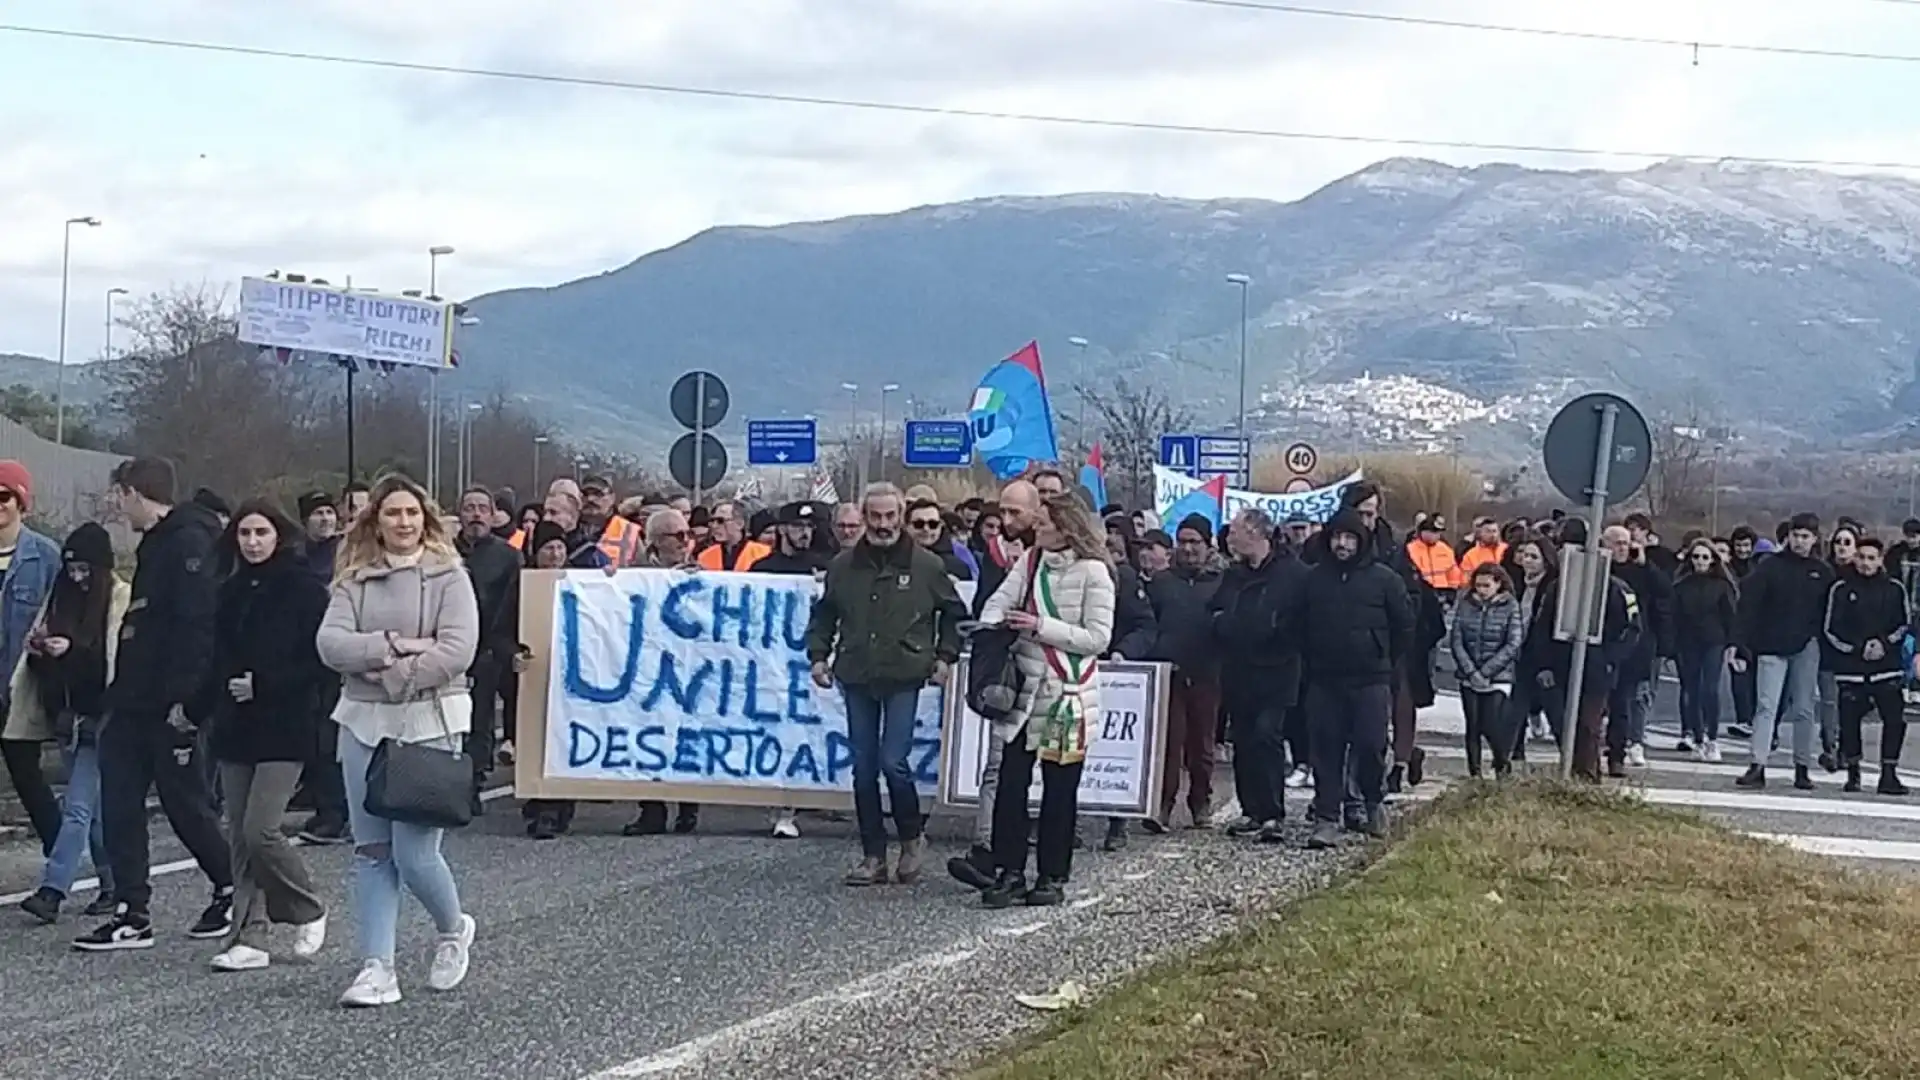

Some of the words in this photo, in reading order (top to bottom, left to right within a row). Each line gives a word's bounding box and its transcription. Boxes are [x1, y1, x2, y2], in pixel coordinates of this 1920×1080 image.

[365, 326, 431, 352] RICCHI
[1291, 451, 1310, 467] 40
[658, 577, 809, 650] CHIU
[560, 590, 823, 726] UNILE
[1101, 709, 1138, 741] ER
